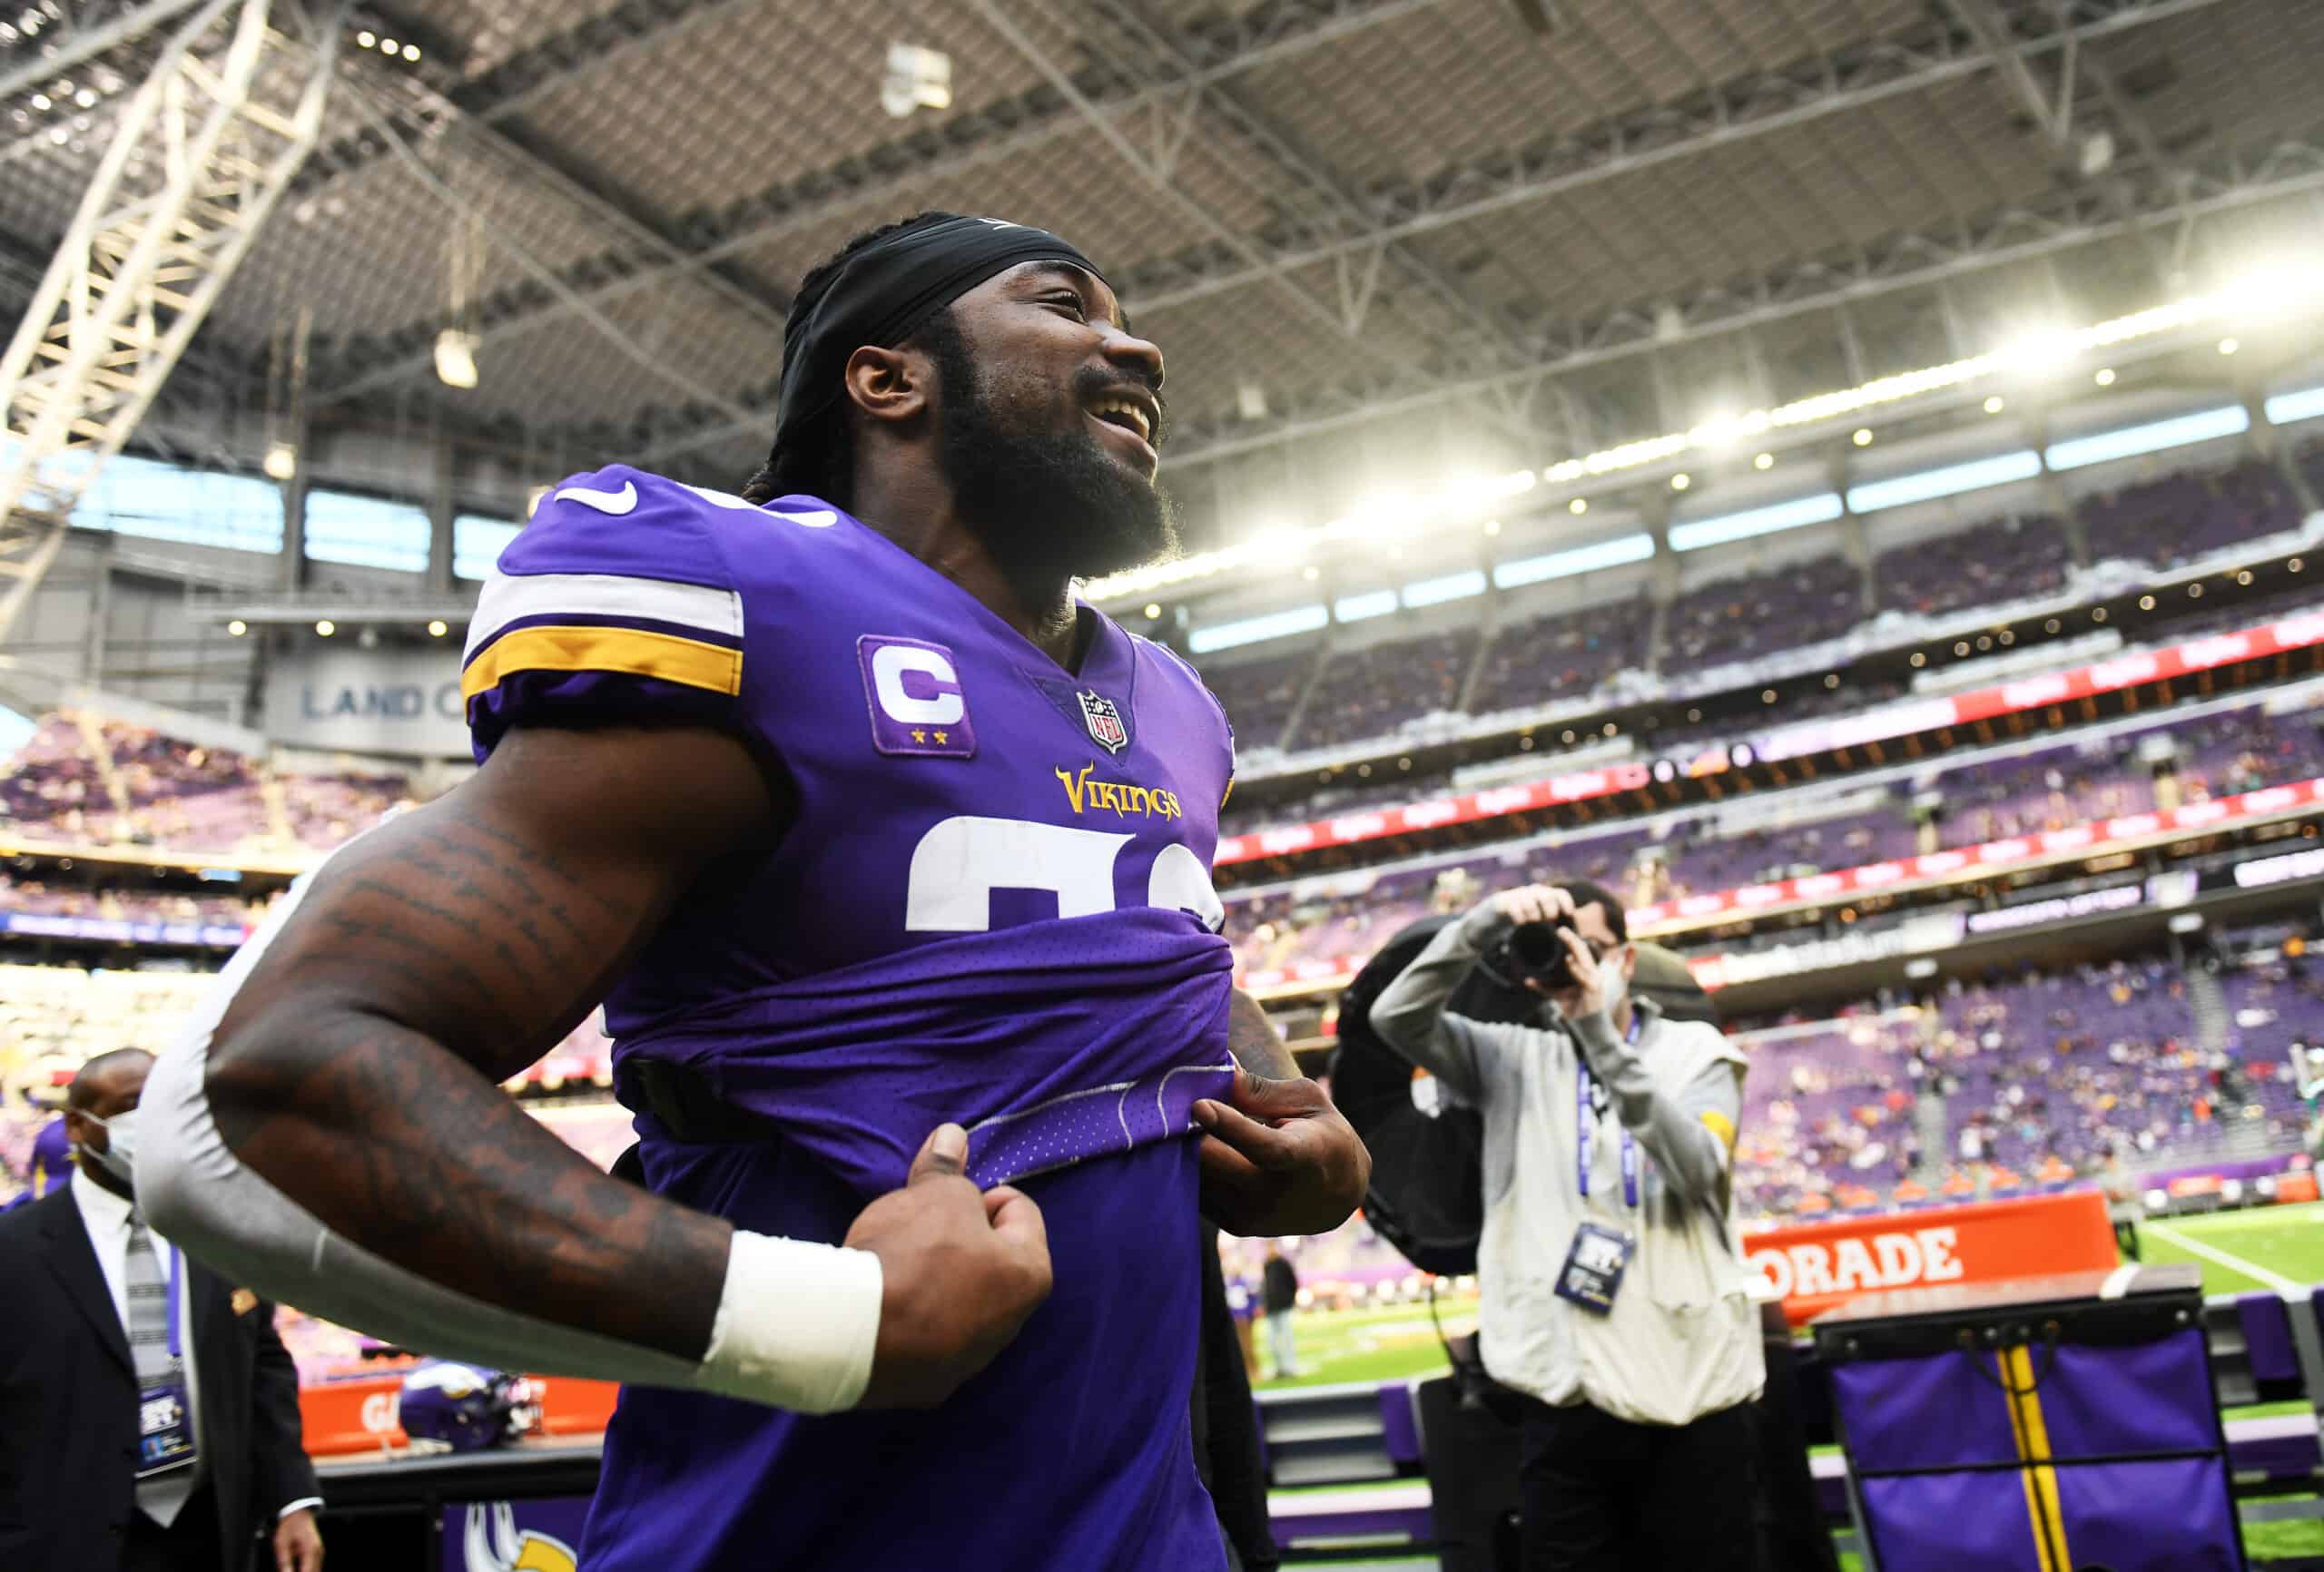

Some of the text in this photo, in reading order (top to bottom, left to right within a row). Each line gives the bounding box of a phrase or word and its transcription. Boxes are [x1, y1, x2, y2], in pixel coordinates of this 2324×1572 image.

[301, 683, 426, 721] LAND
[872, 645, 965, 725] C
[1091, 715, 1122, 741] NFL
